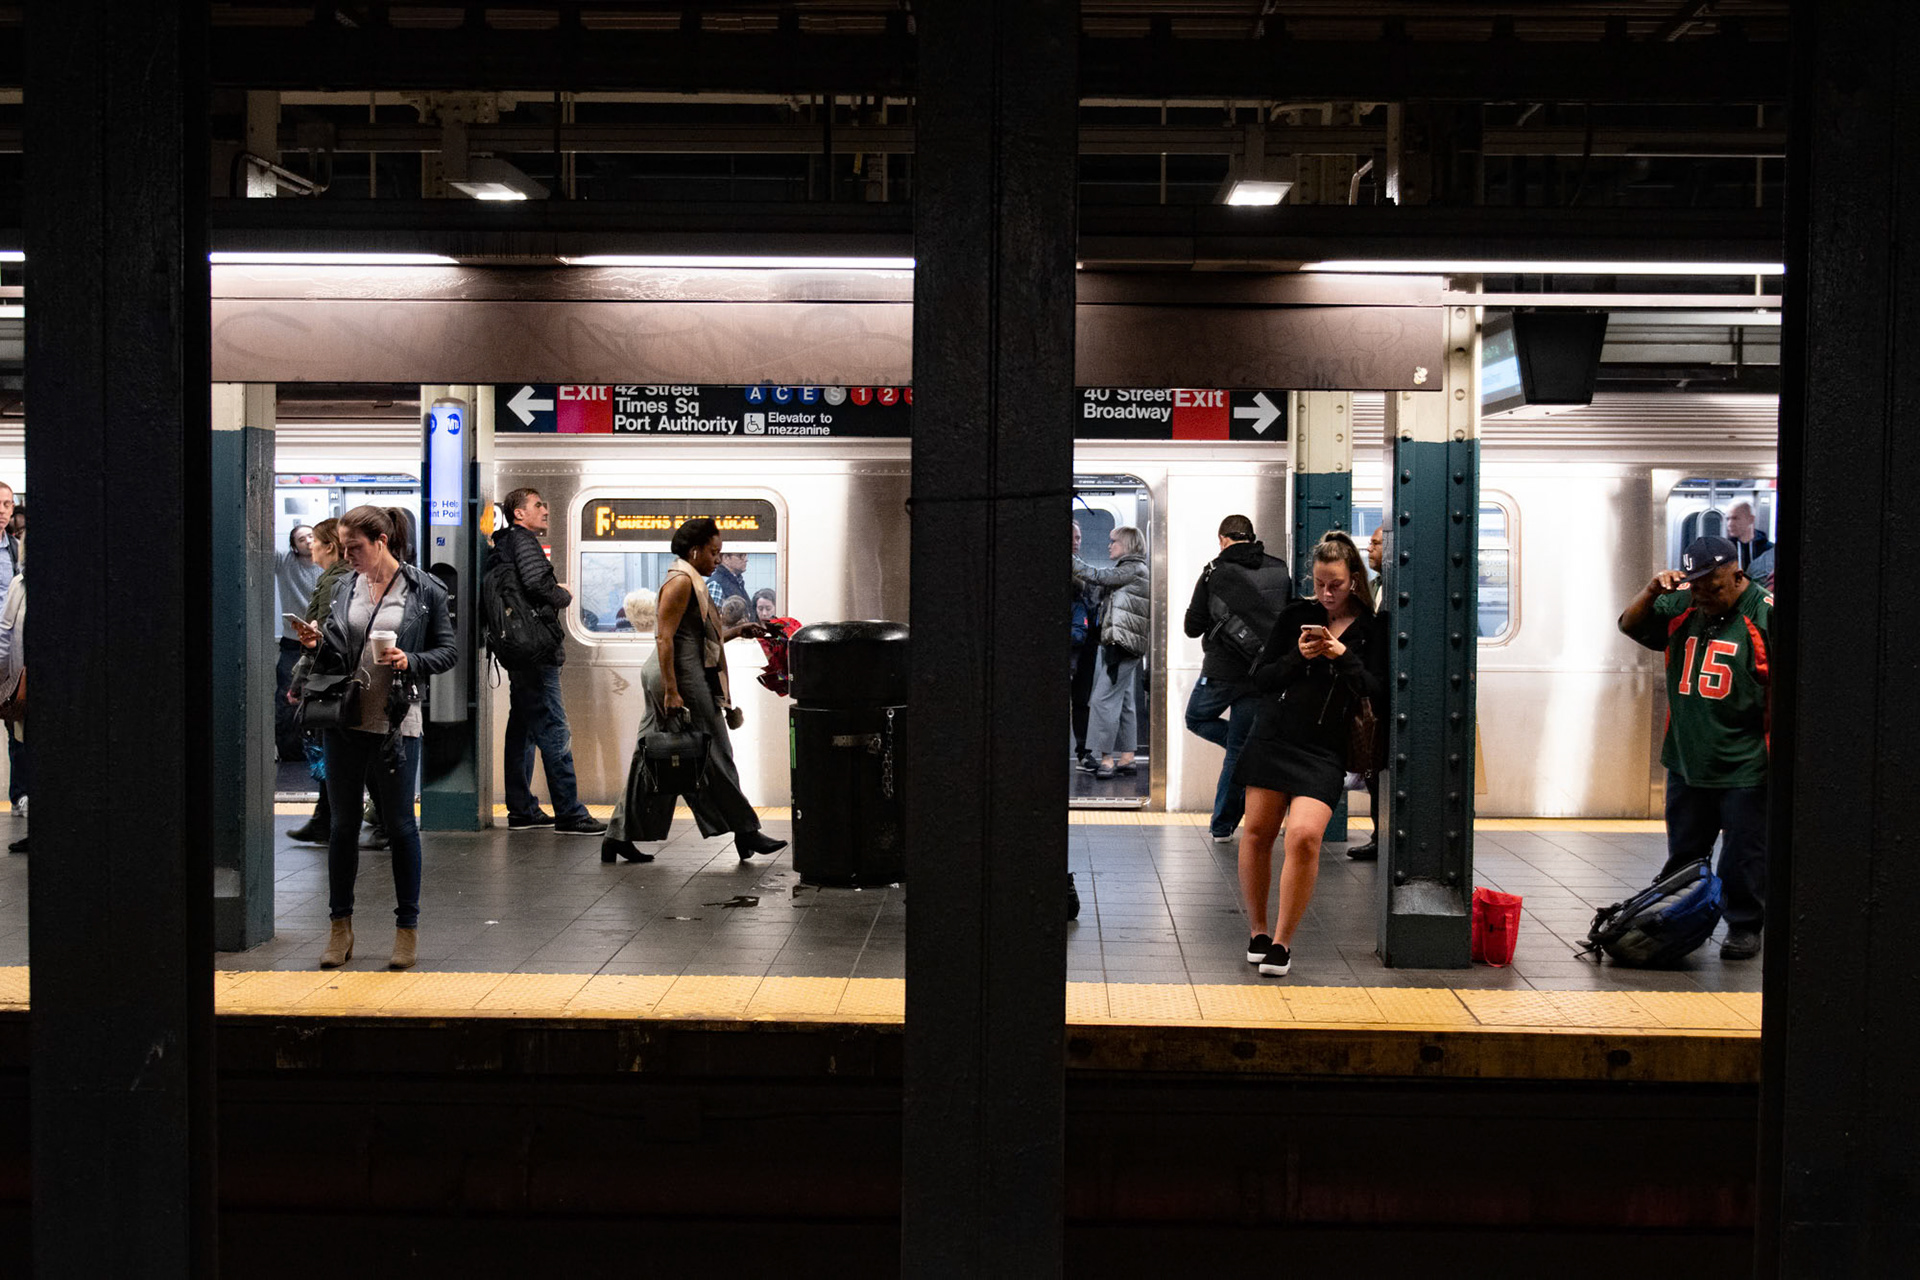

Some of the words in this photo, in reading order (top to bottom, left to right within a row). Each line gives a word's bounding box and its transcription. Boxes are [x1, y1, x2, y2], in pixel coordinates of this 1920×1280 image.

[559, 385, 608, 400] Exit
[614, 385, 638, 396] 42
[645, 385, 700, 397] Street
[749, 387, 762, 400] A
[776, 387, 789, 400] C
[803, 387, 814, 401] E
[830, 387, 841, 401] S
[858, 388, 866, 401] 1
[883, 388, 894, 402] 2
[1084, 388, 1110, 401] 40
[1117, 388, 1172, 402] Street
[1174, 389, 1224, 408] Exit
[615, 397, 668, 414] Times
[675, 397, 700, 417] Sq
[1083, 402, 1172, 422] Broadway
[614, 414, 652, 432] Port
[657, 414, 738, 435] Authority
[768, 411, 816, 424] Elevator
[820, 412, 833, 424] to
[768, 425, 831, 436] mezzanine
[1679, 636, 1739, 700] 15
